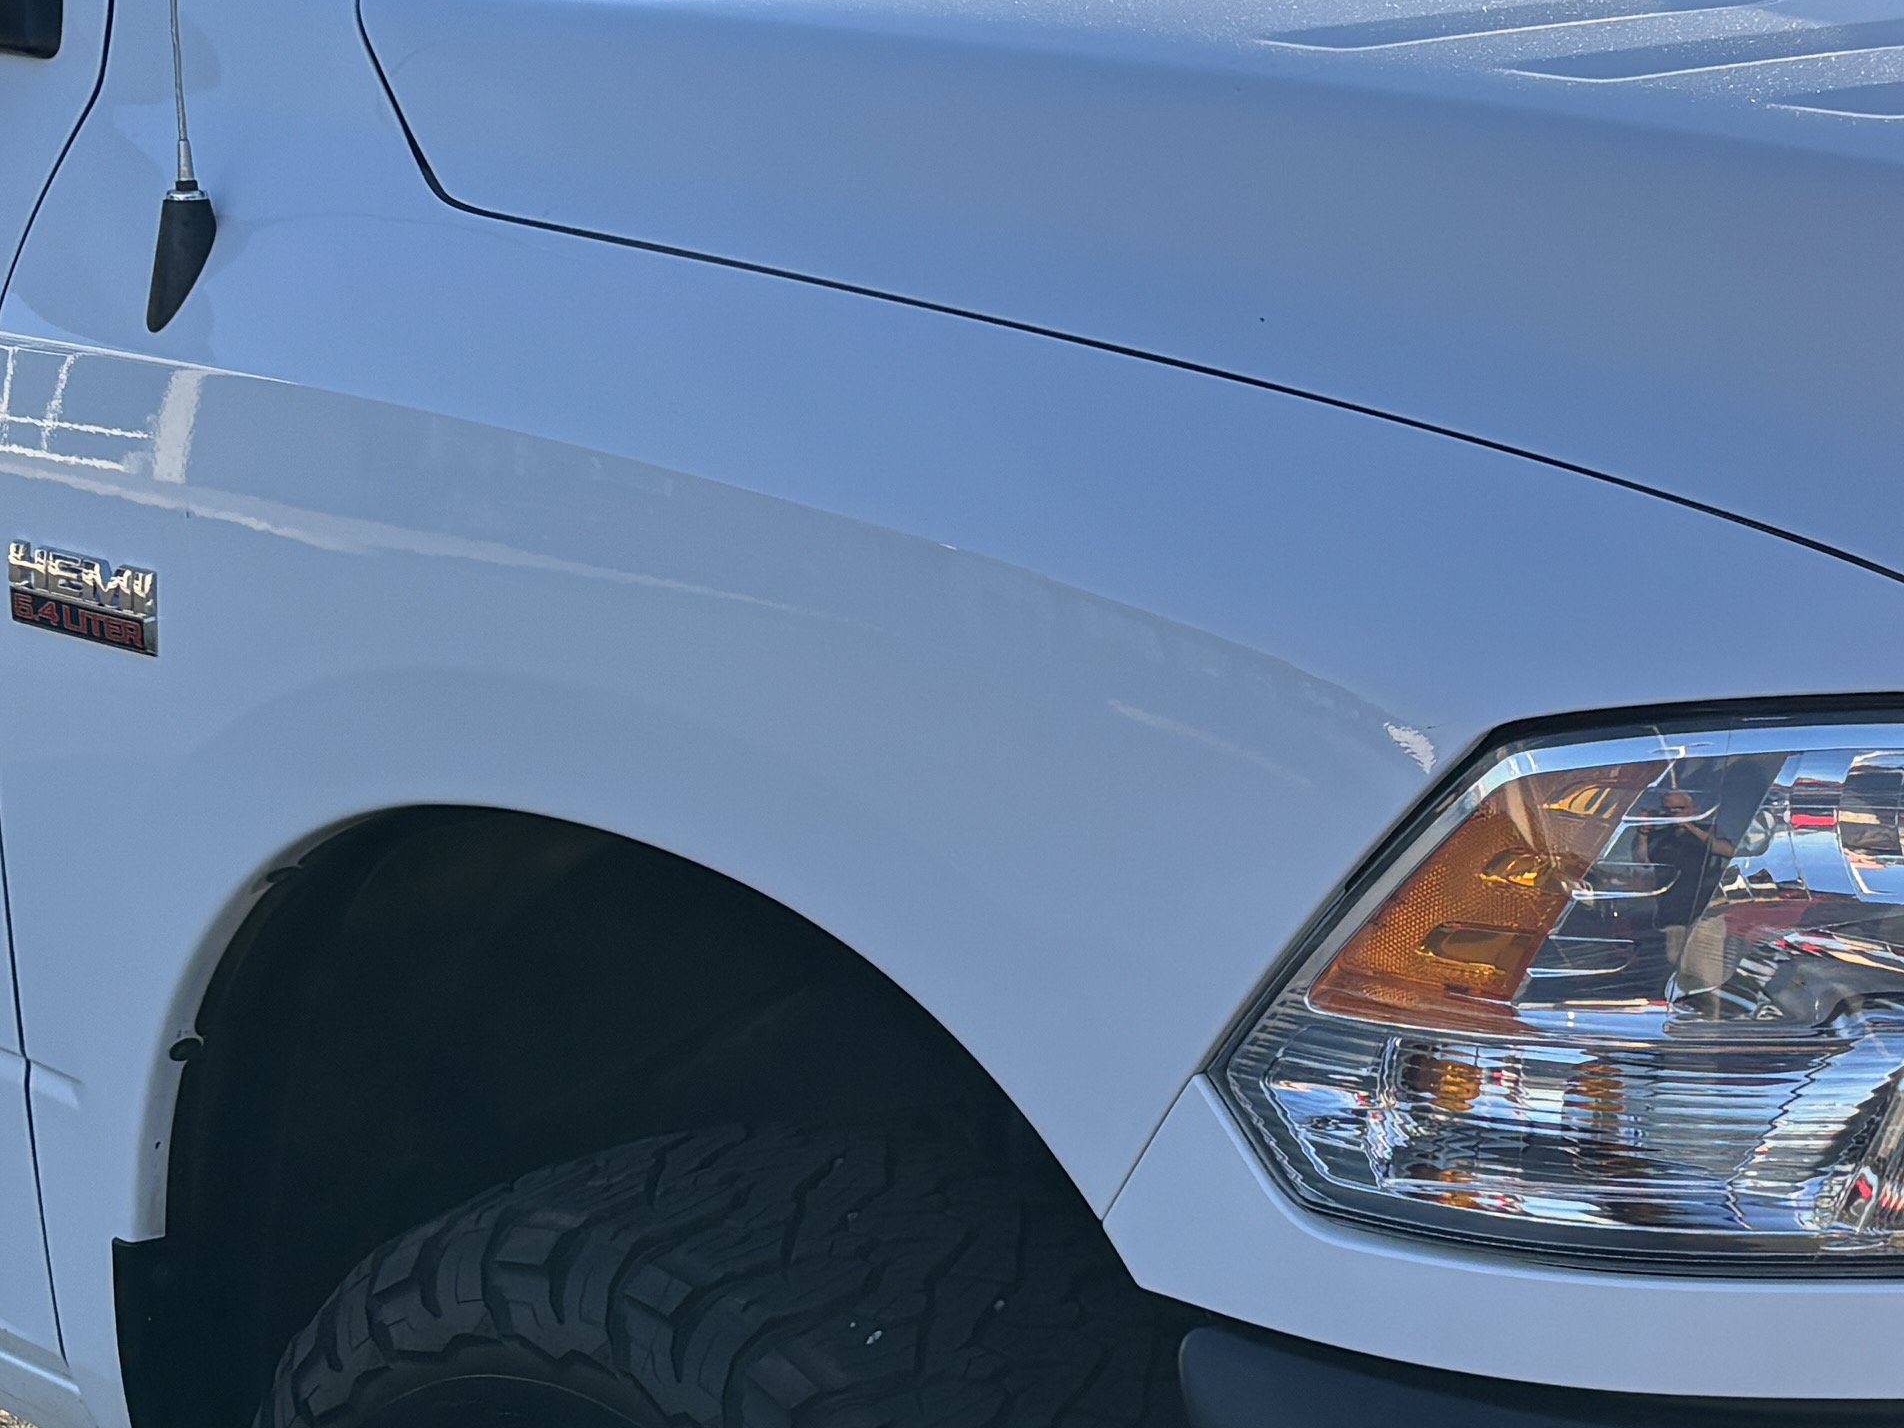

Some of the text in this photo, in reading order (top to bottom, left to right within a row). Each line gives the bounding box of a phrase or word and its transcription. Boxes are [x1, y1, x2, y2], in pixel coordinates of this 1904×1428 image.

[8, 539, 157, 618] HEMI
[14, 592, 144, 648] 6.4 LITER
